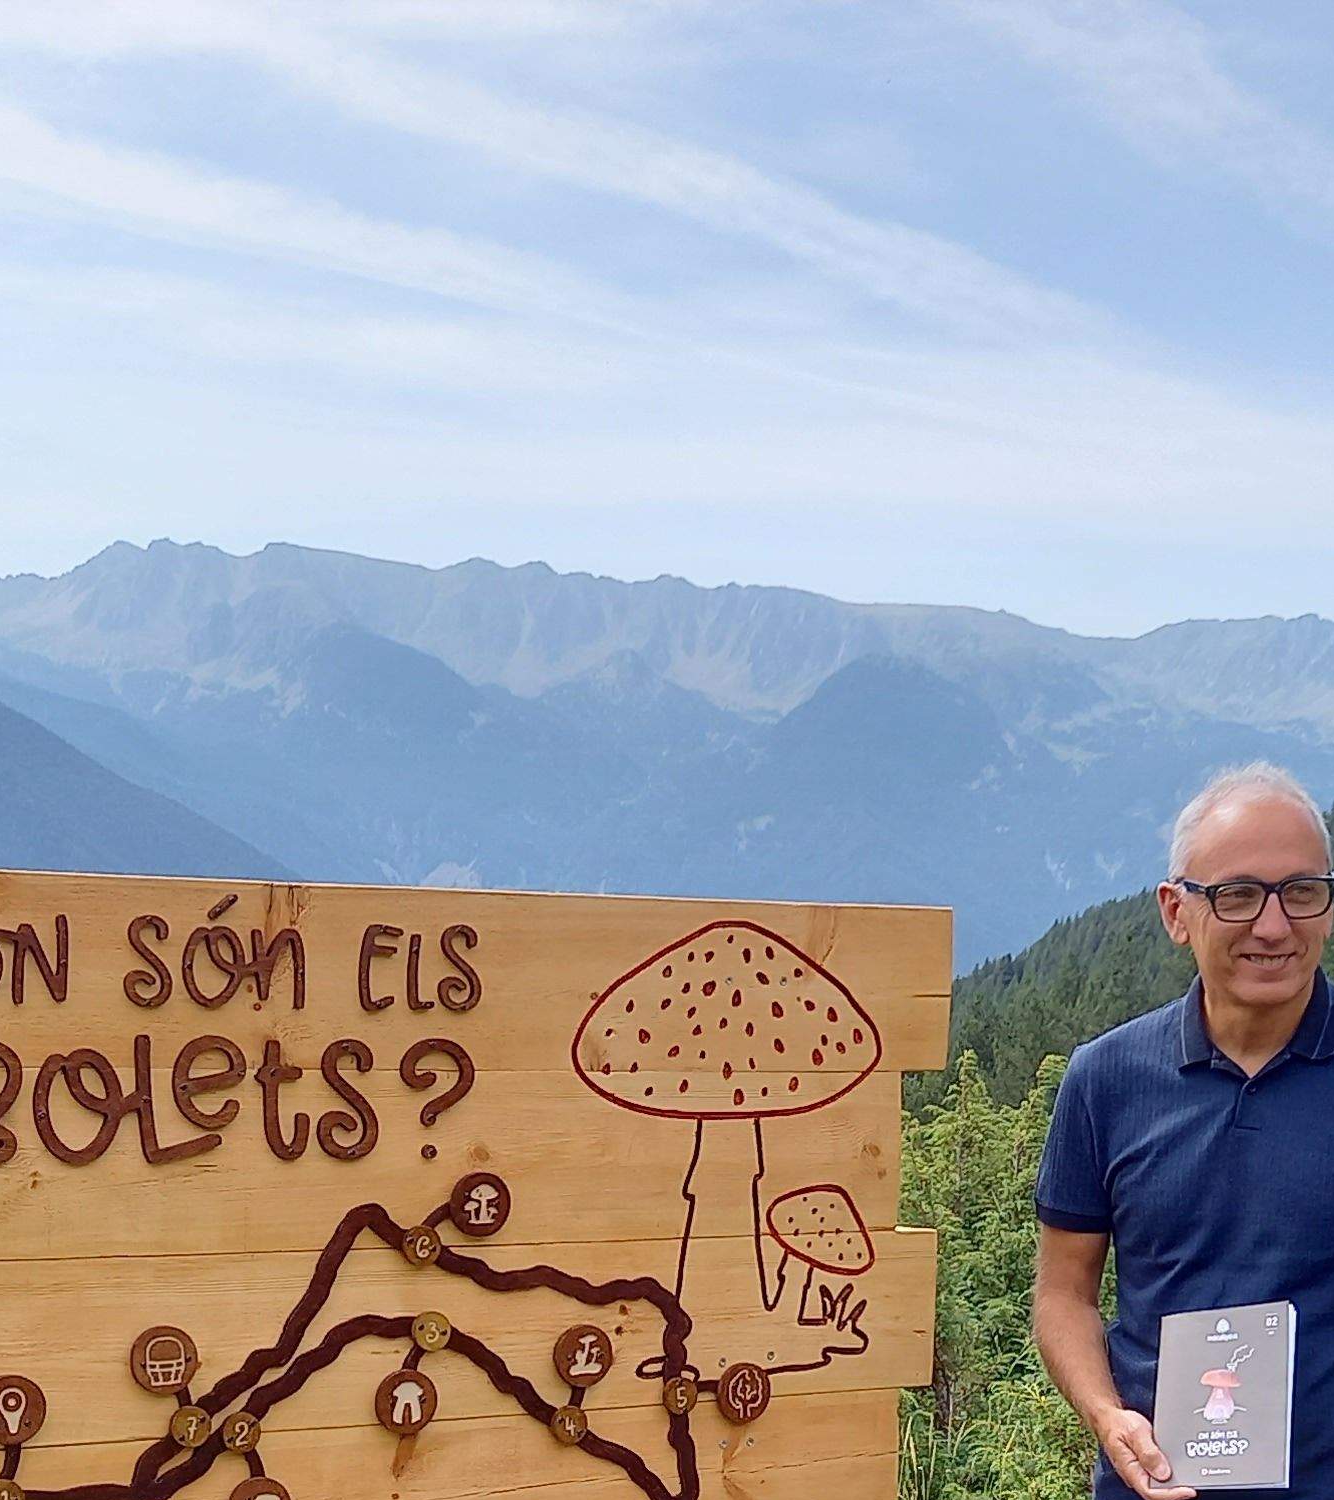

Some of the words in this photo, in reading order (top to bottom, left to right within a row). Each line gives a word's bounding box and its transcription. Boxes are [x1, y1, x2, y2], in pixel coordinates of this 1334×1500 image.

[415, 1235, 431, 1258] 6
[425, 1321, 440, 1343] 3
[675, 1386, 688, 1408] 5
[186, 1415, 199, 1441] 7
[234, 1420, 250, 1447] 2
[564, 1415, 577, 1437] 4
